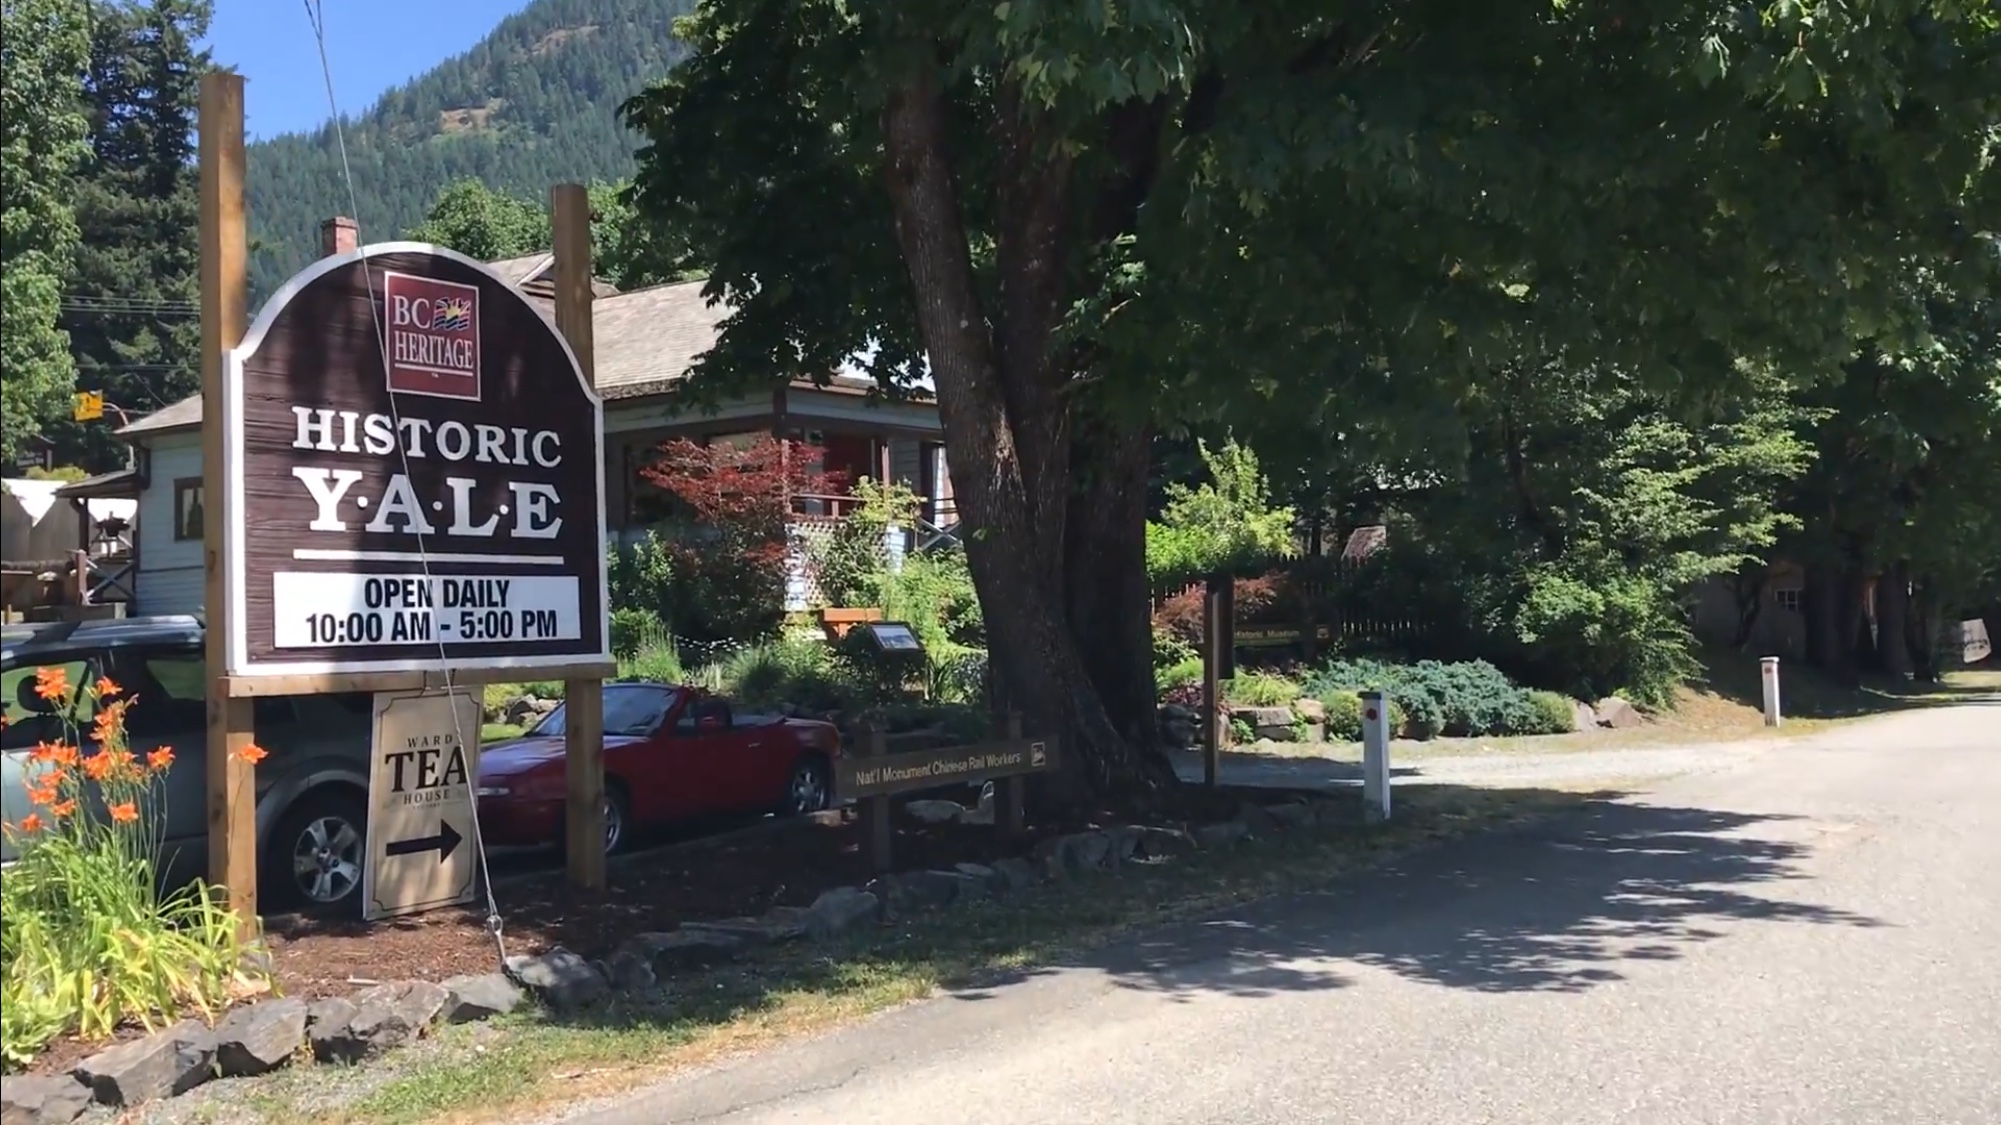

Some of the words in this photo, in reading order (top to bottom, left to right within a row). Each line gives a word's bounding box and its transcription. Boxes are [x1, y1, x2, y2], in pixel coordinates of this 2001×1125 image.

[393, 295, 430, 328] BC
[394, 331, 474, 369] HERITAGE
[292, 406, 562, 467] HISTORIC
[364, 578, 433, 609] OPEN
[443, 579, 510, 608] DAILY
[306, 612, 383, 643] 10:00
[391, 612, 431, 641] AM
[460, 610, 513, 639] 5:00
[521, 610, 557, 637] PM
[407, 734, 453, 748] WARD
[385, 745, 468, 793] TEA
[883, 763, 931, 782] Monument
[932, 759, 968, 775] Chinese
[969, 756, 984, 770] Rail
[985, 751, 1021, 768] Workers
[403, 788, 450, 805] HOUSE
